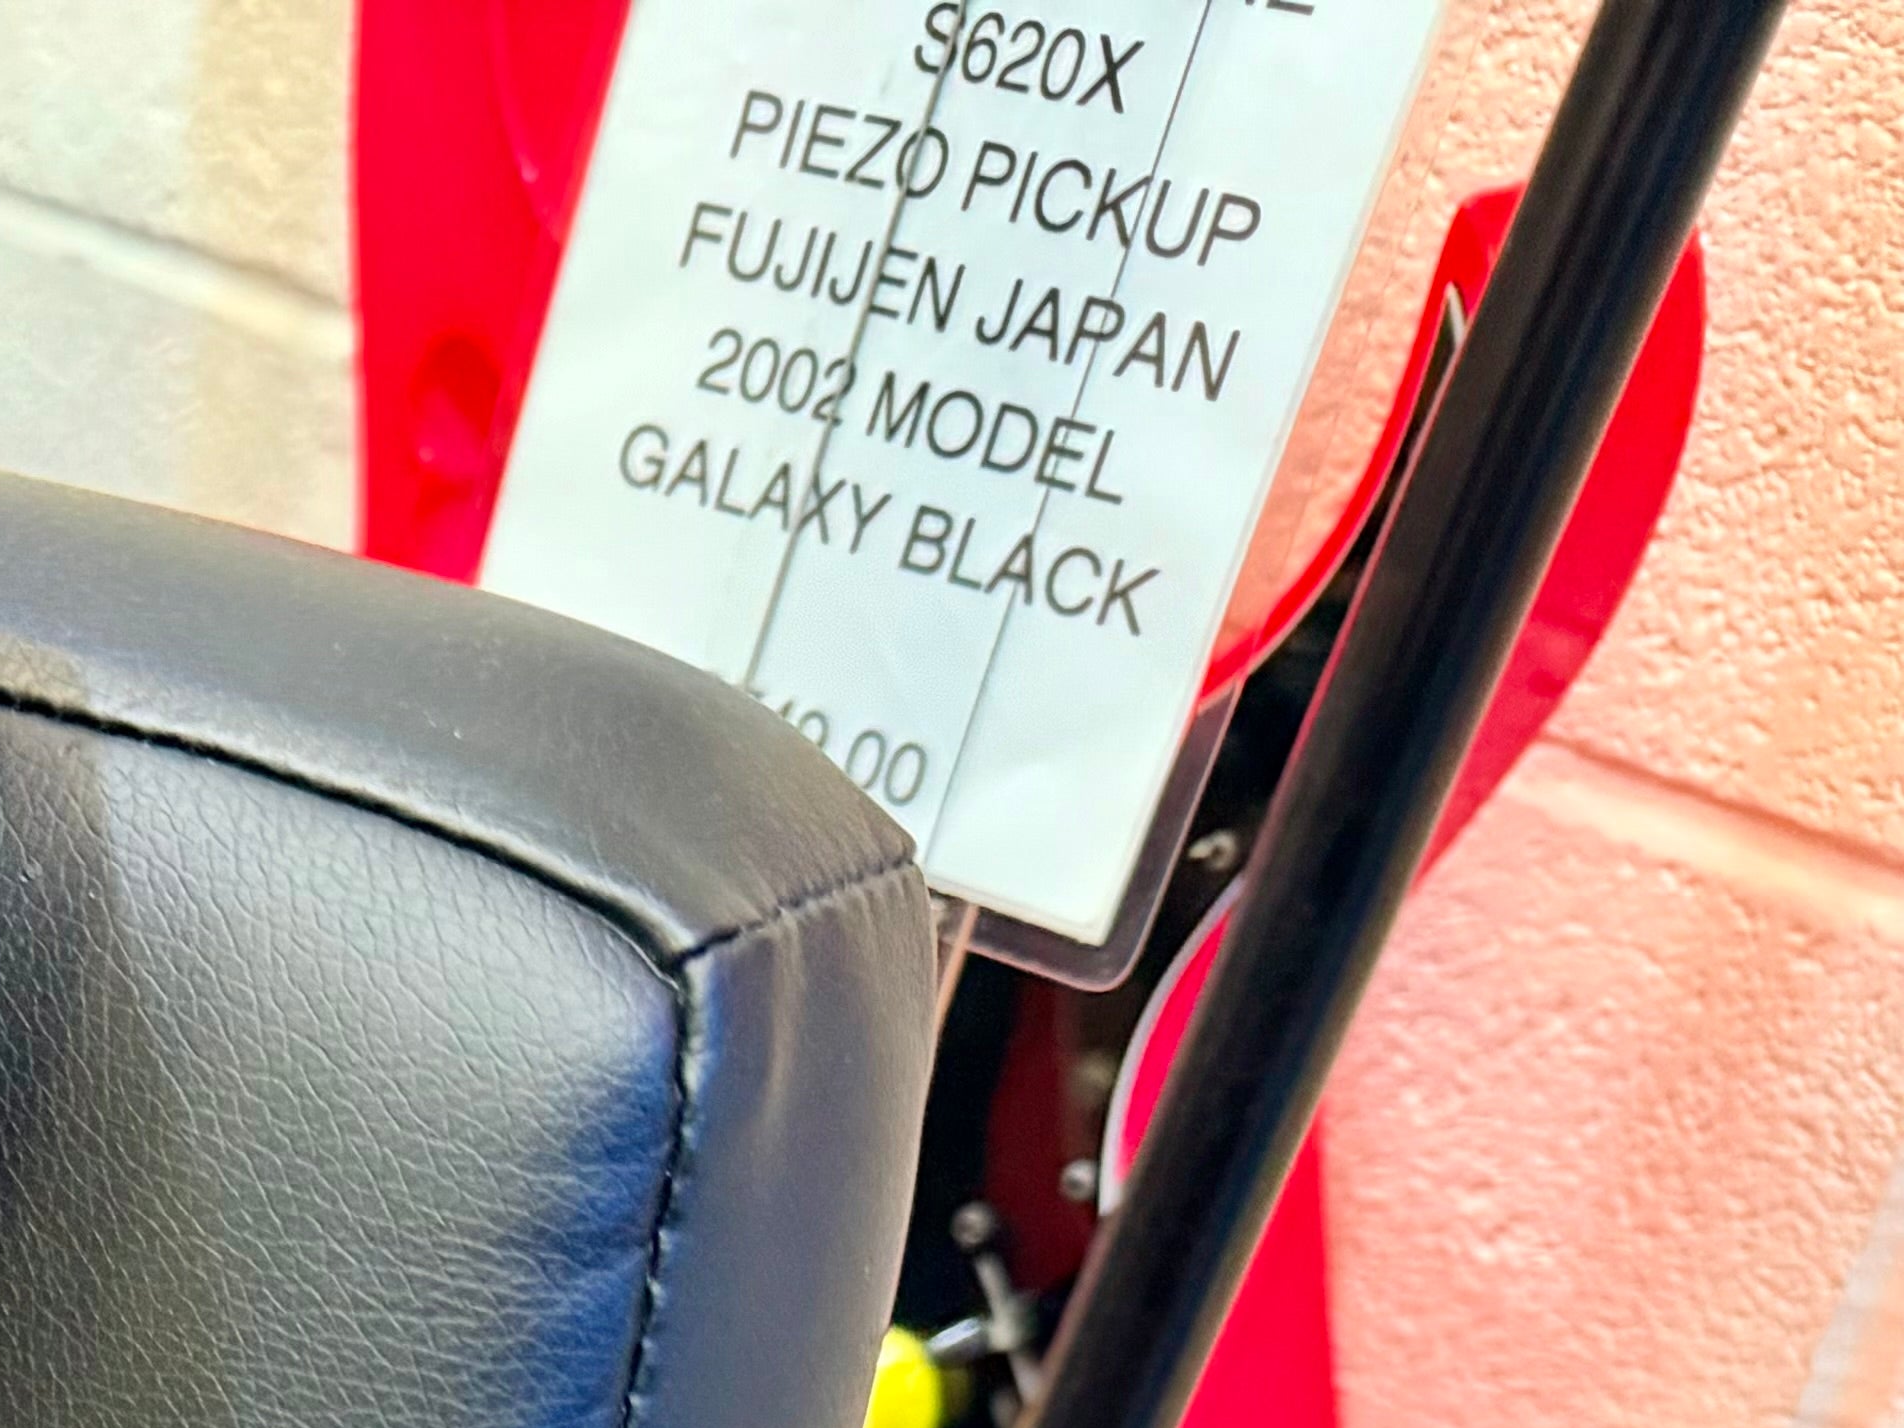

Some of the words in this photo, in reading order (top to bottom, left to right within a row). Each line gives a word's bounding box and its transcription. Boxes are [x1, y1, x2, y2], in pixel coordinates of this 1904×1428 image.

[914, 2, 1145, 114] S620X
[729, 90, 950, 200] PIEZO
[960, 140, 1262, 266] PICKUP
[680, 202, 966, 332] FUJIJEN
[975, 278, 1242, 401] JAPAN
[695, 328, 857, 426] 2002
[865, 371, 1124, 505] MODEL
[619, 423, 892, 555] GALAXY
[898, 504, 1161, 637] BLACK
